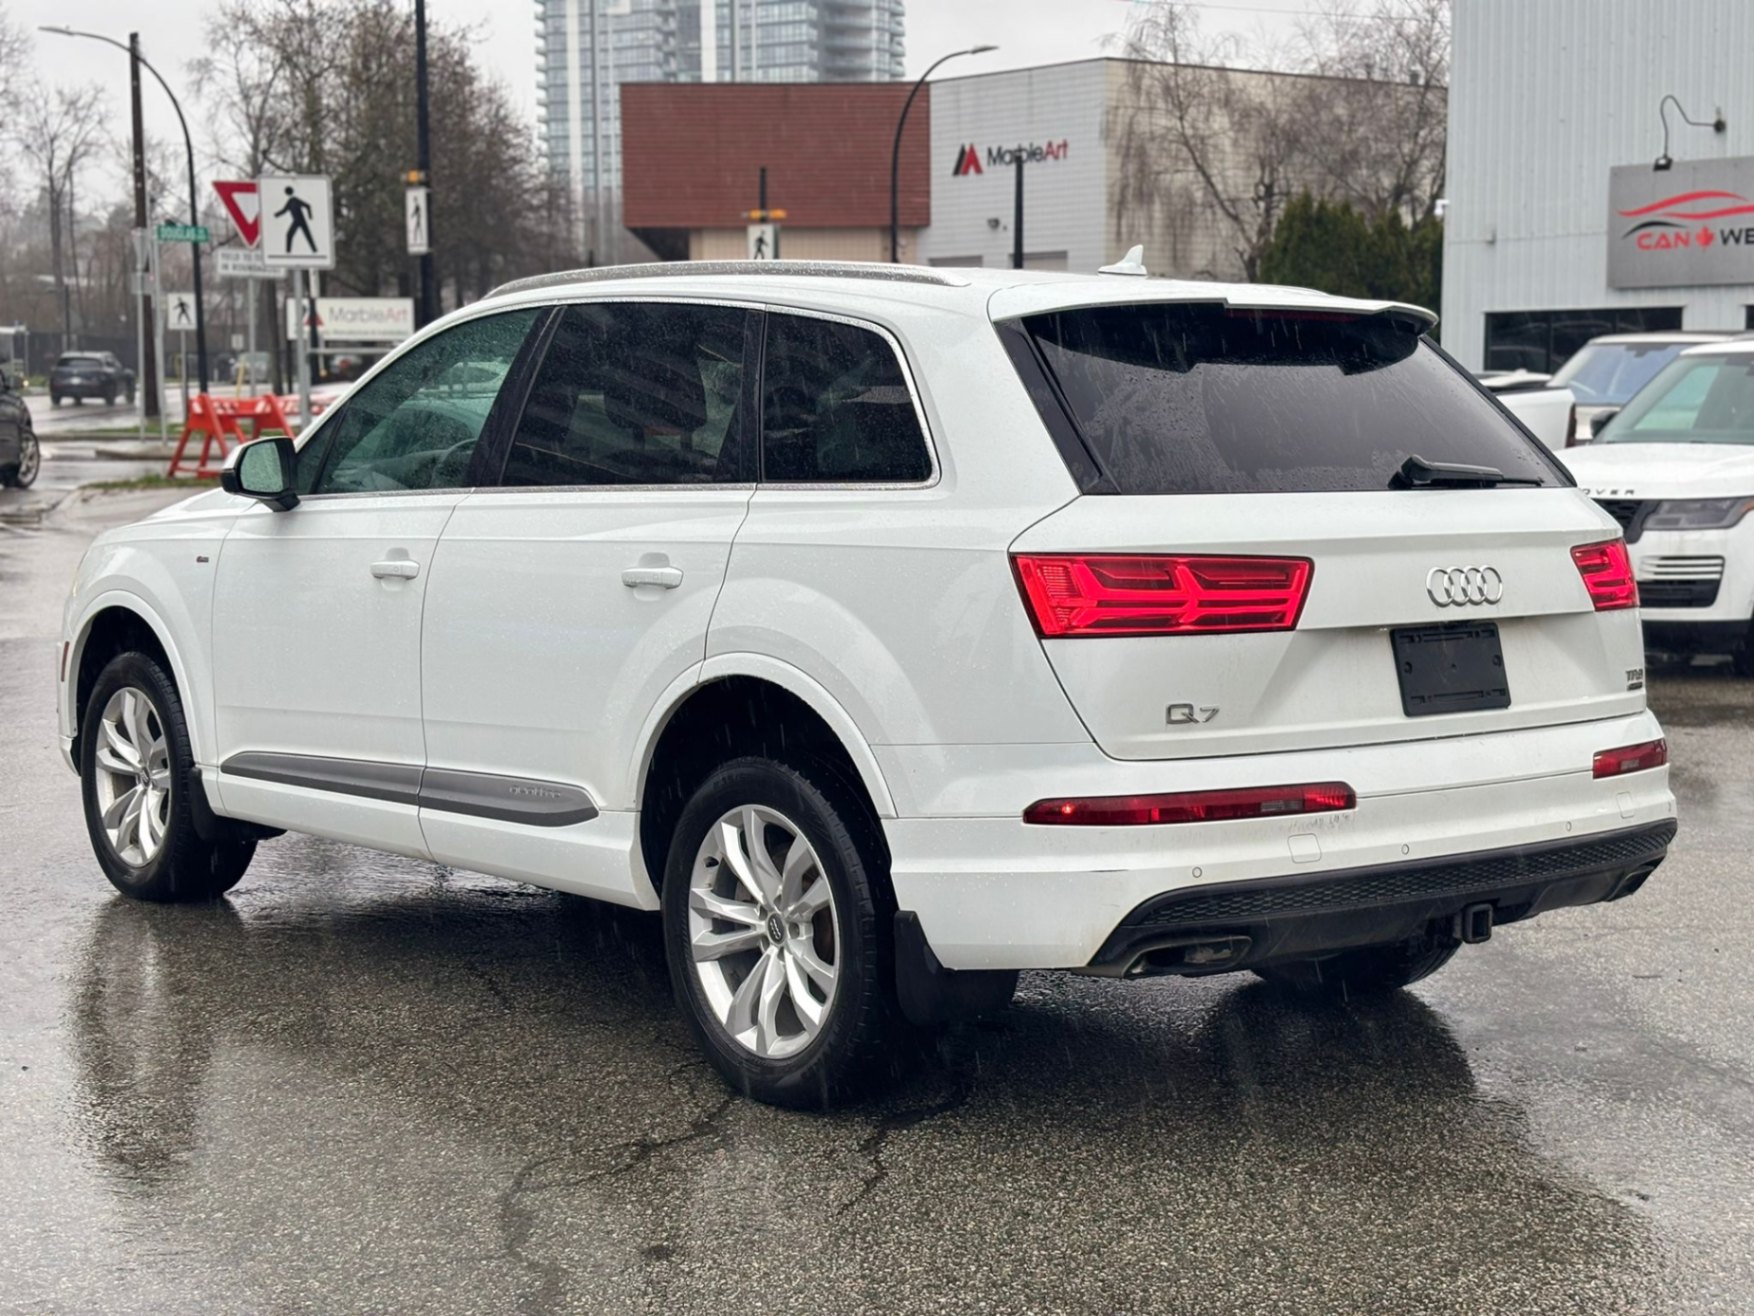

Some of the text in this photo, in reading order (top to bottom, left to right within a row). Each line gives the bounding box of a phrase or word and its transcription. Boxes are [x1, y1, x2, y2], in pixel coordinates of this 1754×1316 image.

[1636, 227, 1754, 250] CAN WE
[1165, 703, 1219, 724] Q7
